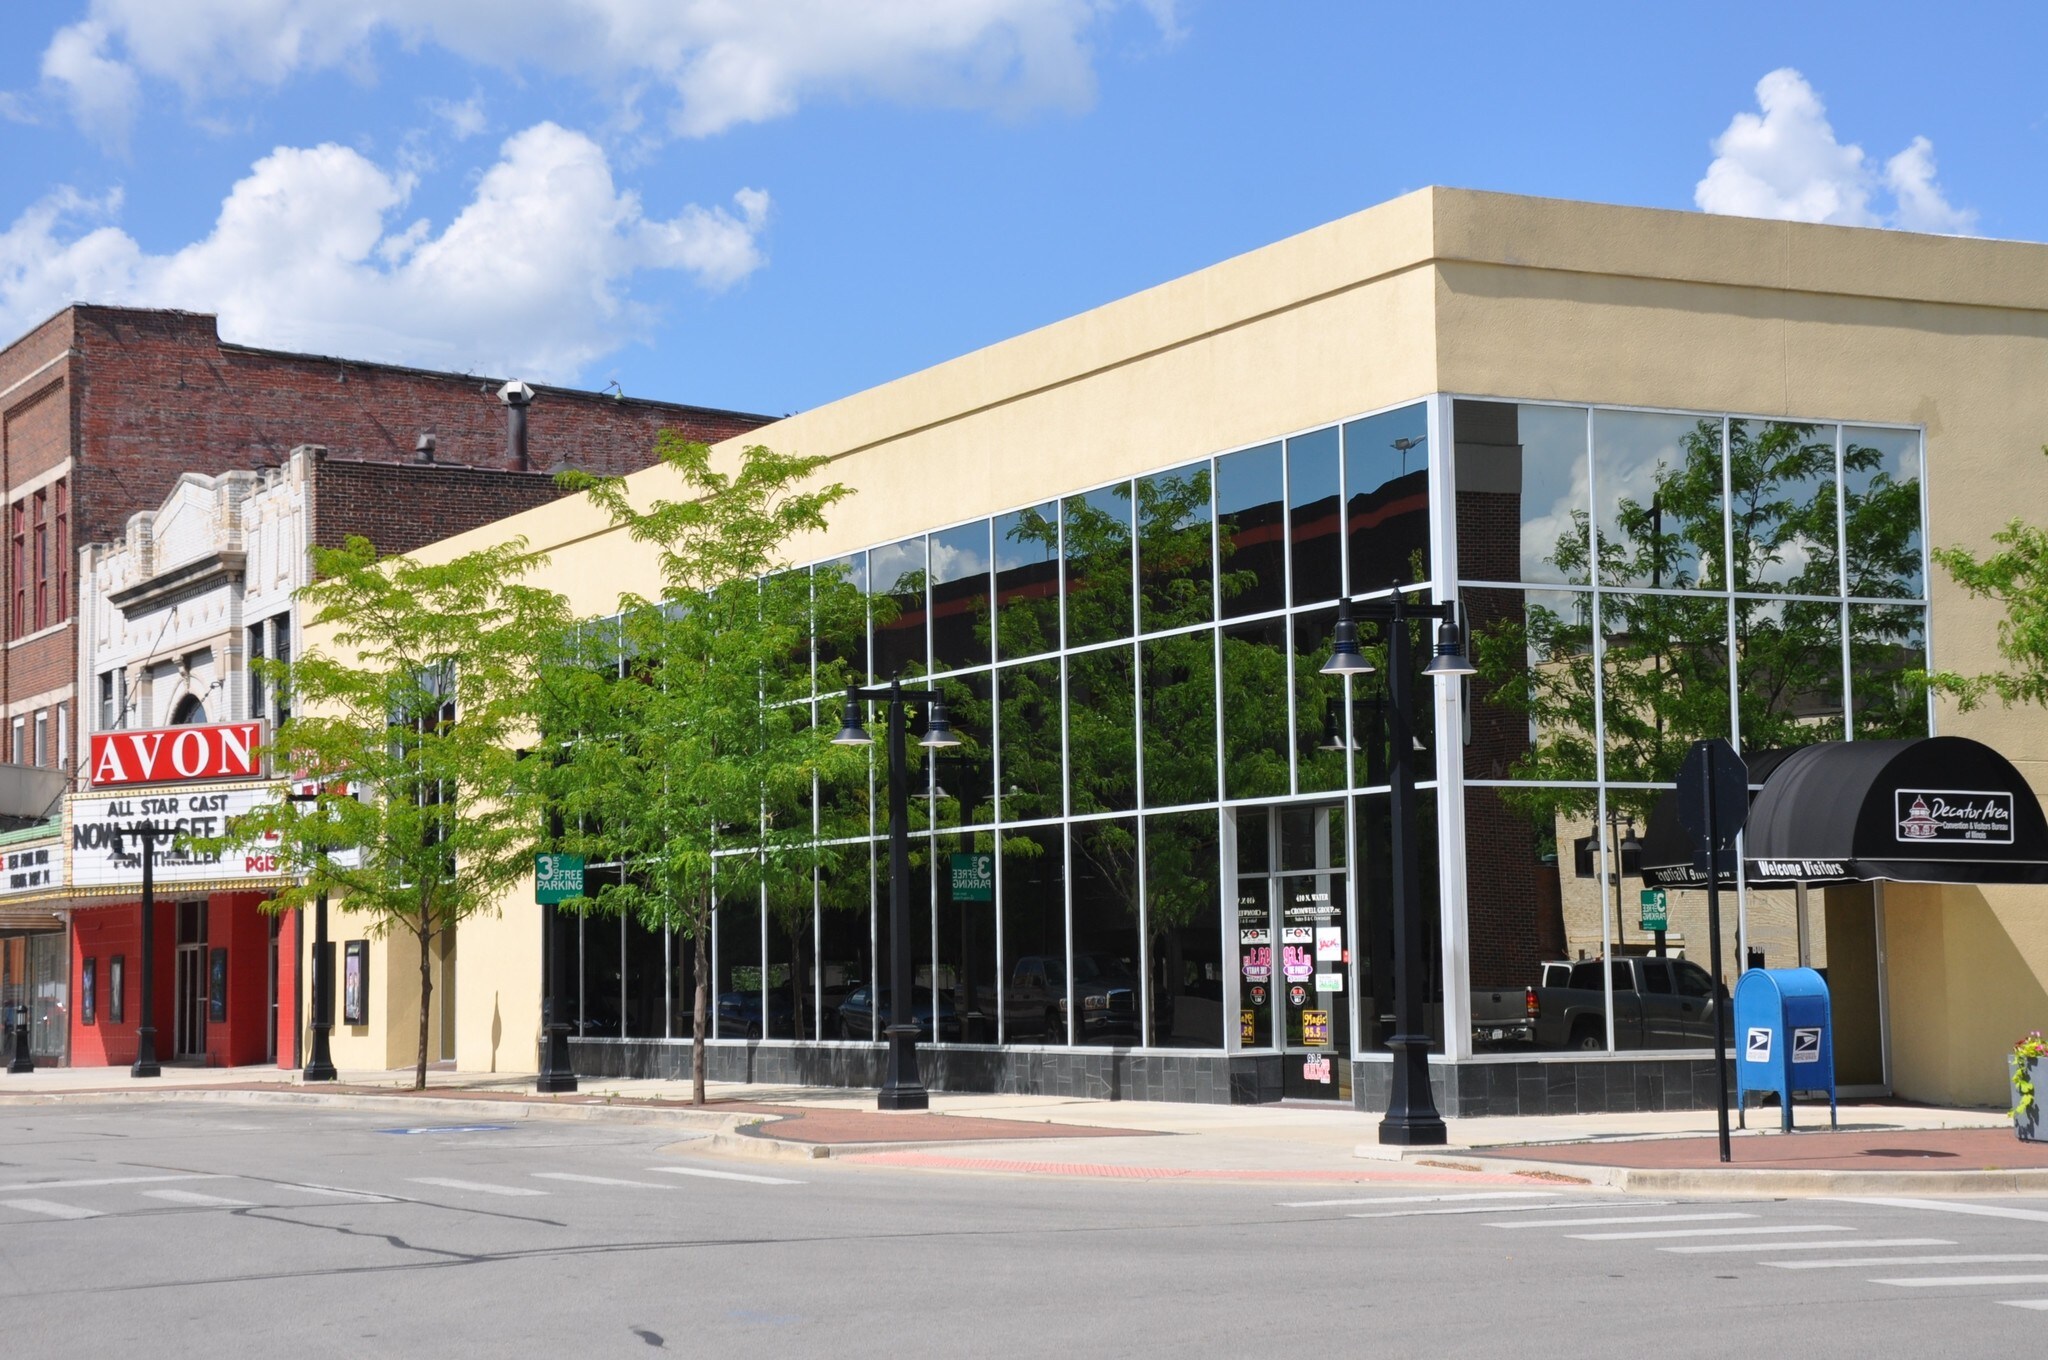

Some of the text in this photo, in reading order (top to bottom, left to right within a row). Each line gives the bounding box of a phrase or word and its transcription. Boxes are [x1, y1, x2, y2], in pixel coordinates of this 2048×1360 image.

[93, 727, 254, 782] AVON
[107, 795, 228, 817] ALL STAR CAST
[1932, 798, 2009, 820] Decatur Area
[1971, 831, 1987, 839] Illinois
[1991, 823, 2008, 831] Bureau
[73, 821, 121, 850] NOW
[246, 856, 279, 873] PG13
[538, 856, 552, 880] 3
[553, 856, 561, 880] HOUR
[1758, 860, 1844, 876] Welcome Visitors
[560, 870, 583, 880] FREE
[537, 881, 583, 890] PARKING
[1311, 893, 1328, 901] WATER
[1286, 928, 1311, 937] FOX
[1283, 946, 1303, 965] 93.1
[1304, 1014, 1326, 1026] Magic
[1305, 1027, 1321, 1038] 95.5
